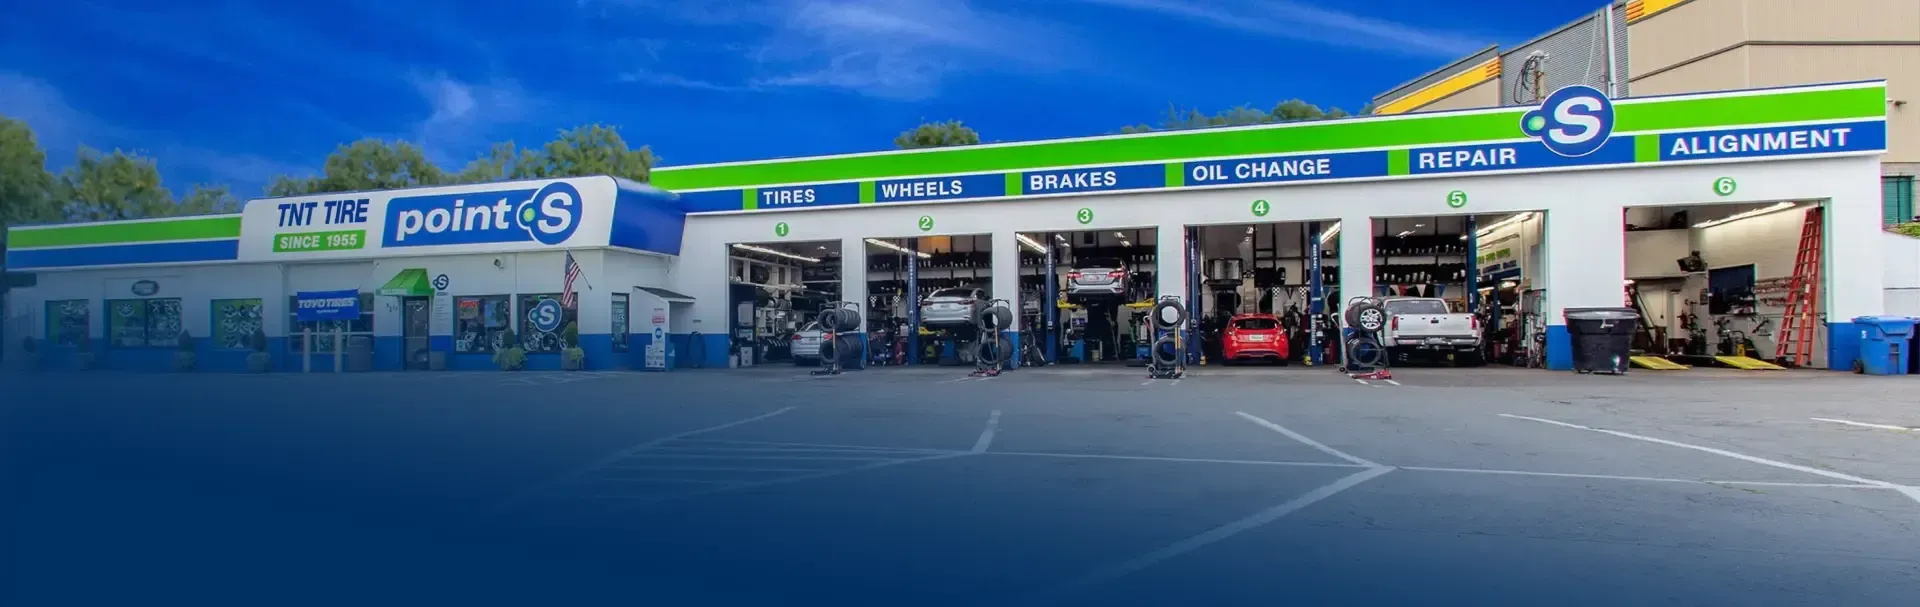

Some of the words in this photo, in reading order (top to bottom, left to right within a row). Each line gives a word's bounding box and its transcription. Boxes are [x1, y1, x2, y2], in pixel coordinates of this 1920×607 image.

[1548, 95, 1603, 144] S
[1671, 128, 1851, 156] ALIGNMENT
[1419, 147, 1517, 169] REPAIR
[1193, 164, 1228, 181] OIL
[1235, 158, 1331, 179] CHANGE
[882, 180, 963, 199] WHEELS
[1030, 171, 1117, 191] BRAKES
[1717, 179, 1732, 193] 6
[763, 188, 816, 205] TIRES
[1451, 192, 1463, 206] 5
[278, 202, 318, 227] TNT
[324, 198, 370, 224] TIRE
[396, 197, 512, 241] point
[537, 191, 573, 234] S
[1080, 209, 1090, 222] 3
[1254, 201, 1266, 214] 4
[778, 223, 786, 235] 1
[920, 217, 931, 229] 2
[280, 235, 320, 249] SINCE
[327, 234, 357, 248] 1955
[298, 299, 326, 309] TOYO
[326, 297, 358, 308] TIRES
[538, 304, 556, 325] S
